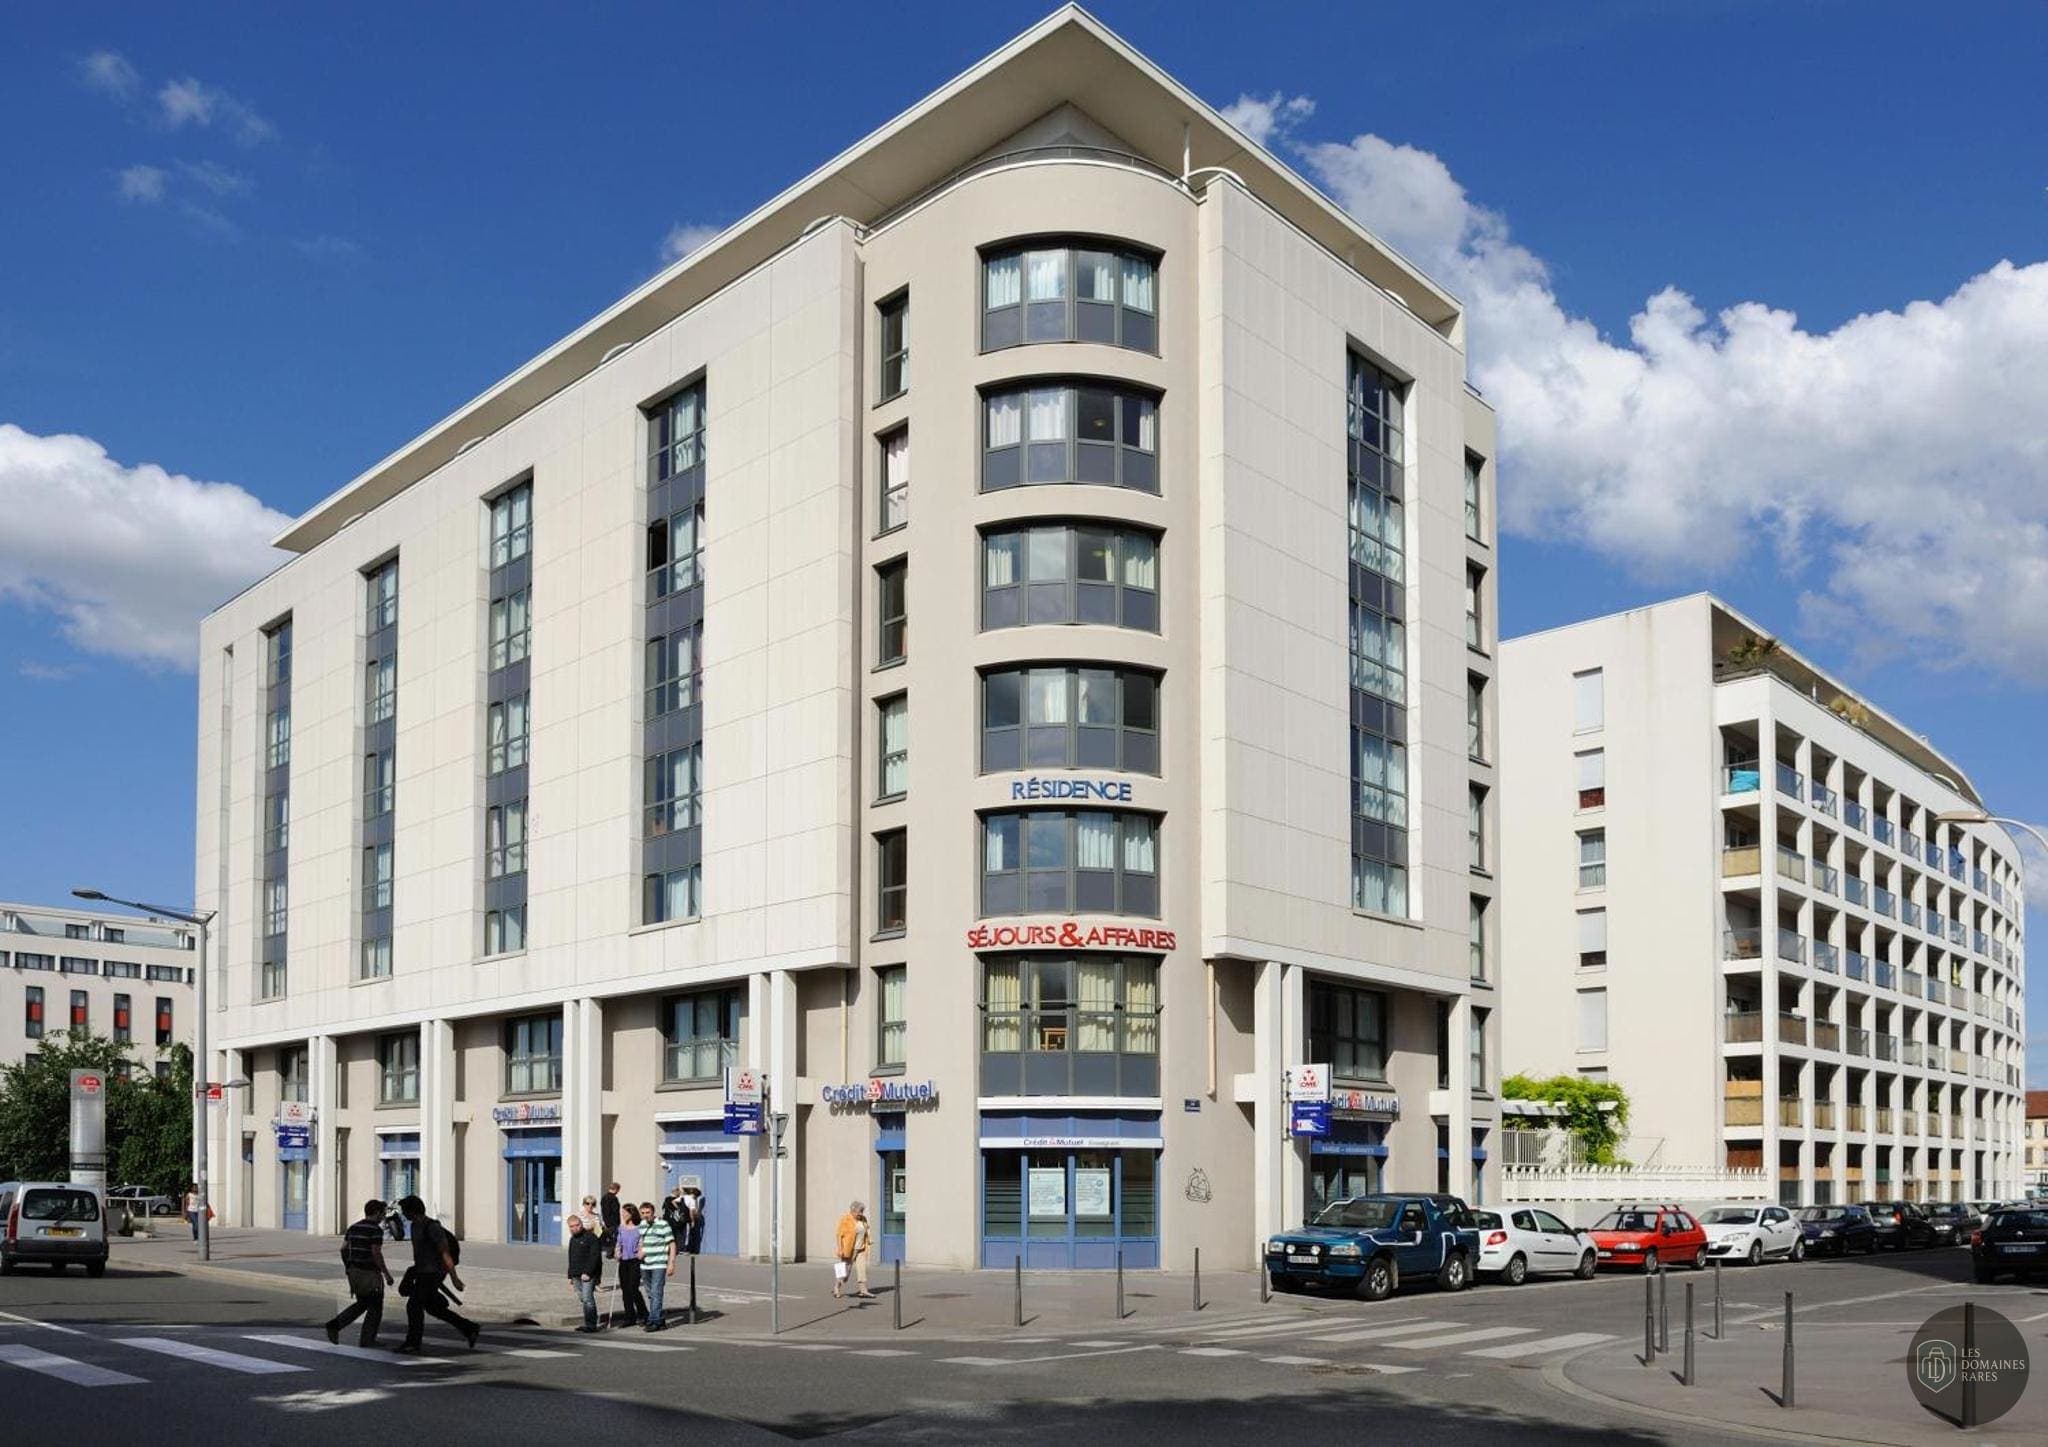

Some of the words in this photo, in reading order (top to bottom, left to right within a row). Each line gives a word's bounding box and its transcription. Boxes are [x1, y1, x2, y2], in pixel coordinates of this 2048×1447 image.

[1012, 777, 1132, 801] RÉSIDENCE
[822, 1083, 865, 1102] Crédit
[881, 1080, 933, 1100] Mutuel
